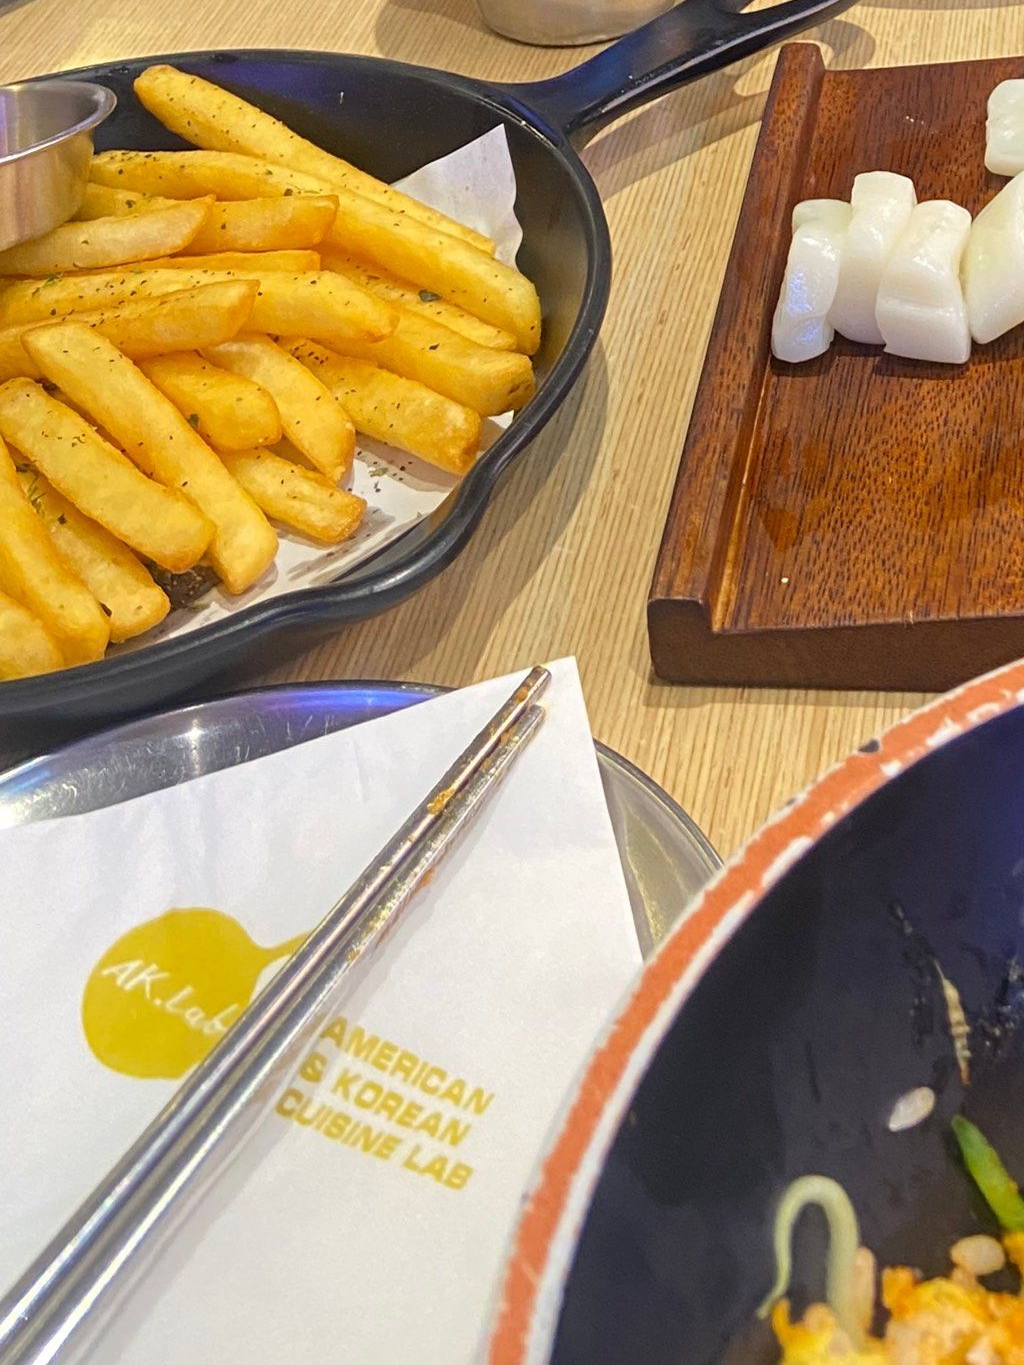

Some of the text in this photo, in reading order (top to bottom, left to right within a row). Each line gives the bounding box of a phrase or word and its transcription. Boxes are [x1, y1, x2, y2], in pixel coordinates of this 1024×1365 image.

[101, 959, 239, 1035] AK.Lab
[299, 1051, 472, 1147] & KOREAN
[319, 1015, 495, 1116] AMERICAN
[275, 1088, 475, 1190] CUISINE LAB
